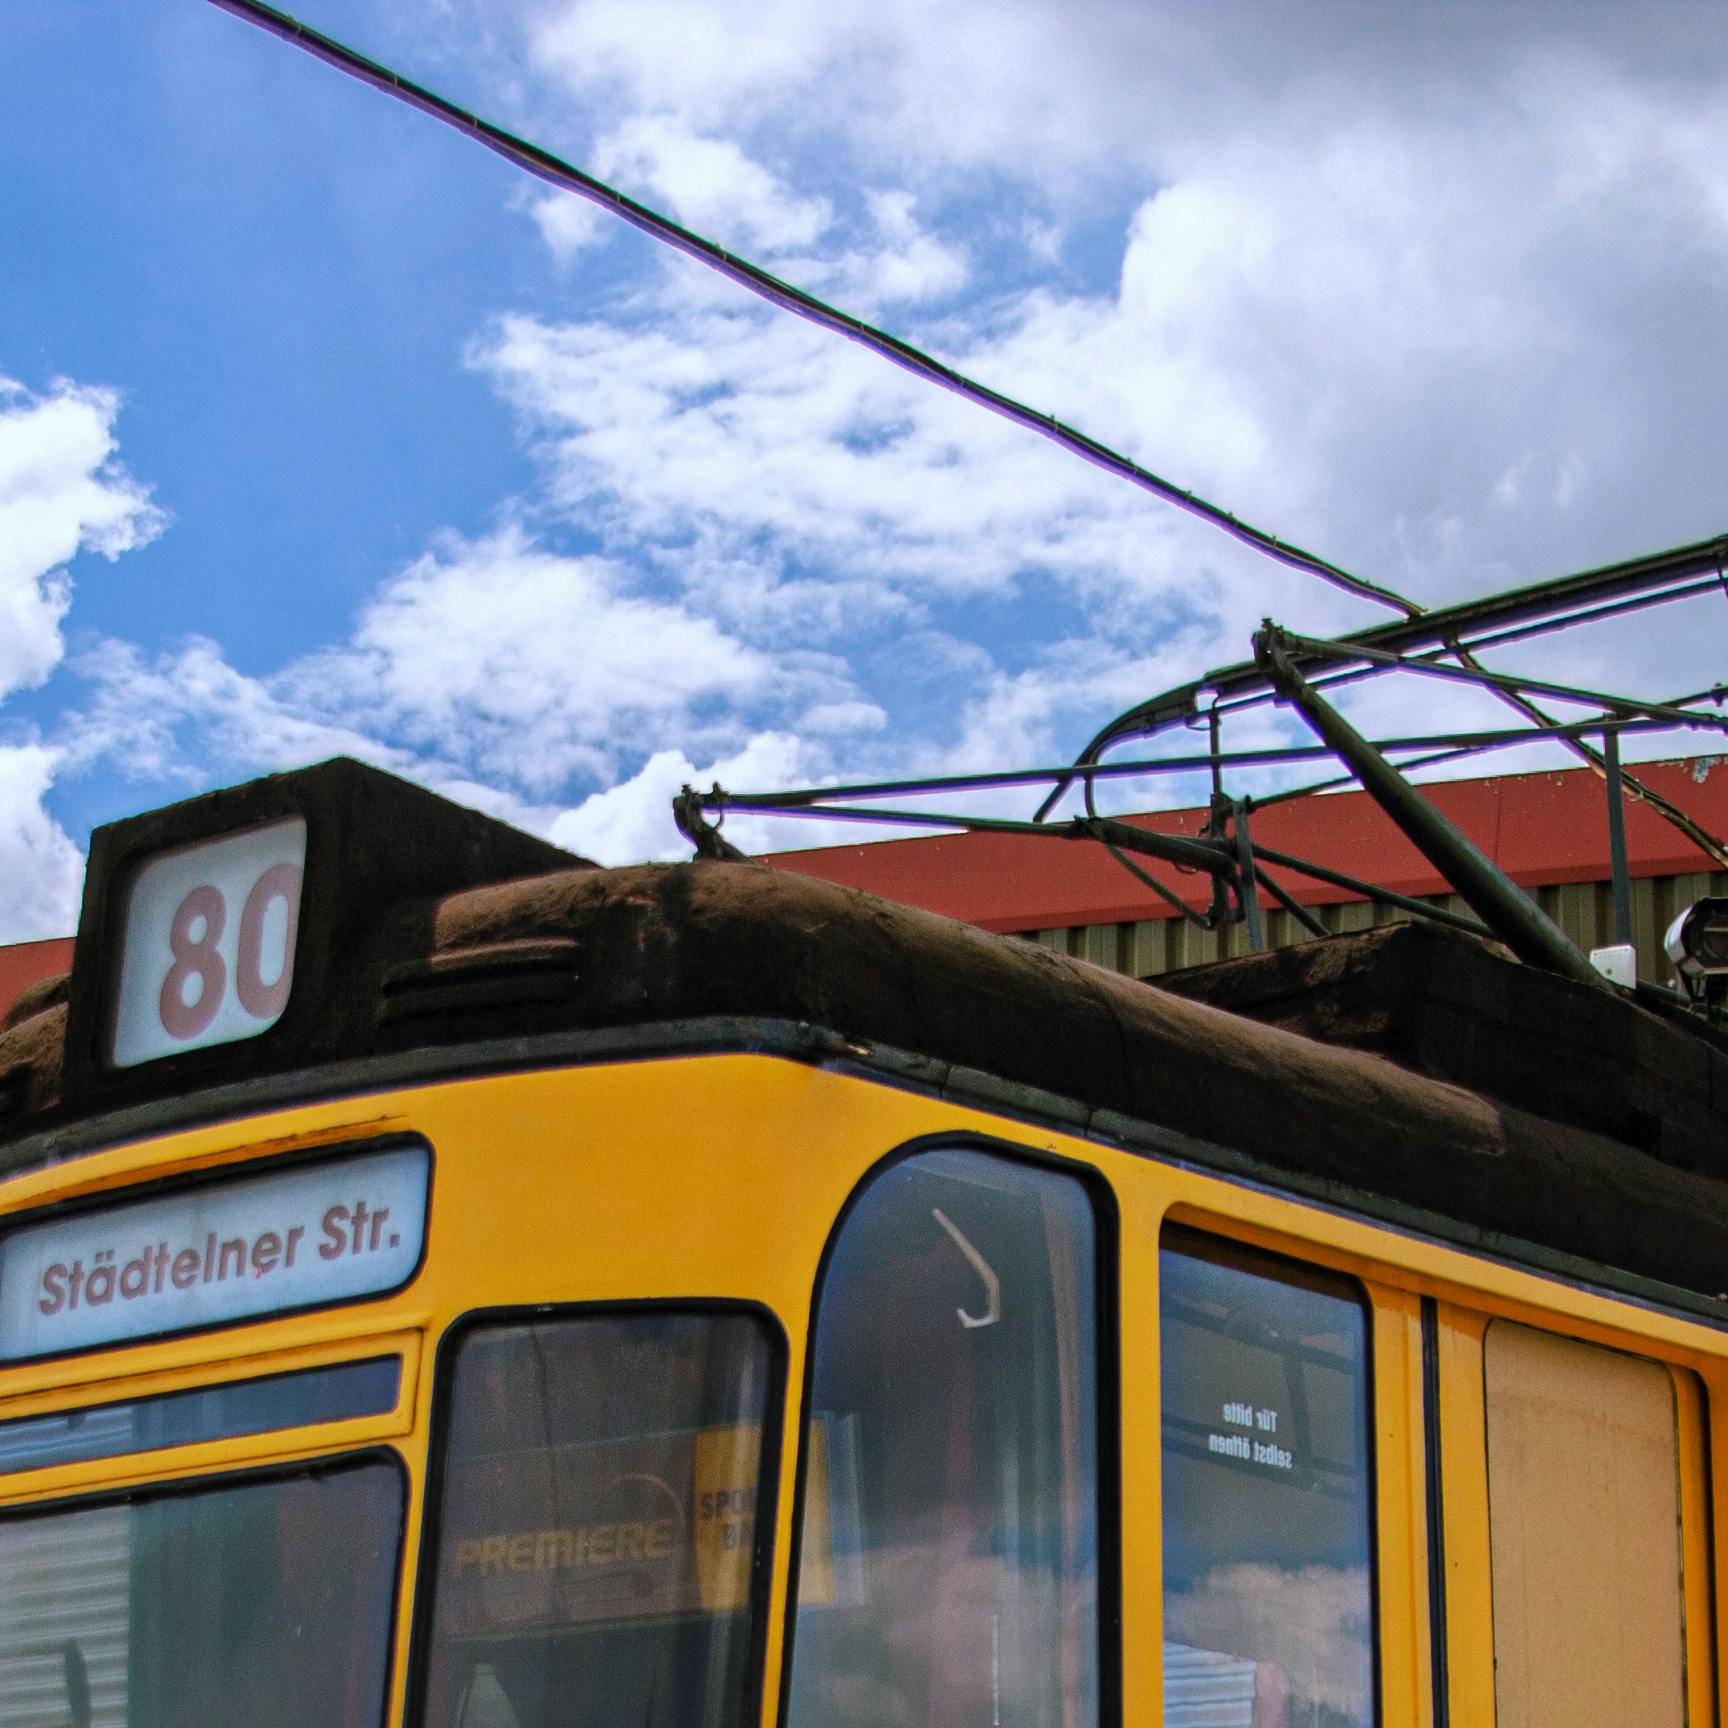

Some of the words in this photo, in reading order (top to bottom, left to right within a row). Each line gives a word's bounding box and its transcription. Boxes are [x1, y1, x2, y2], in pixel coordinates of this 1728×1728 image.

[160, 864, 303, 1040] 80
[38, 1226, 305, 1316] Städtelner
[318, 1201, 401, 1260] Str.
